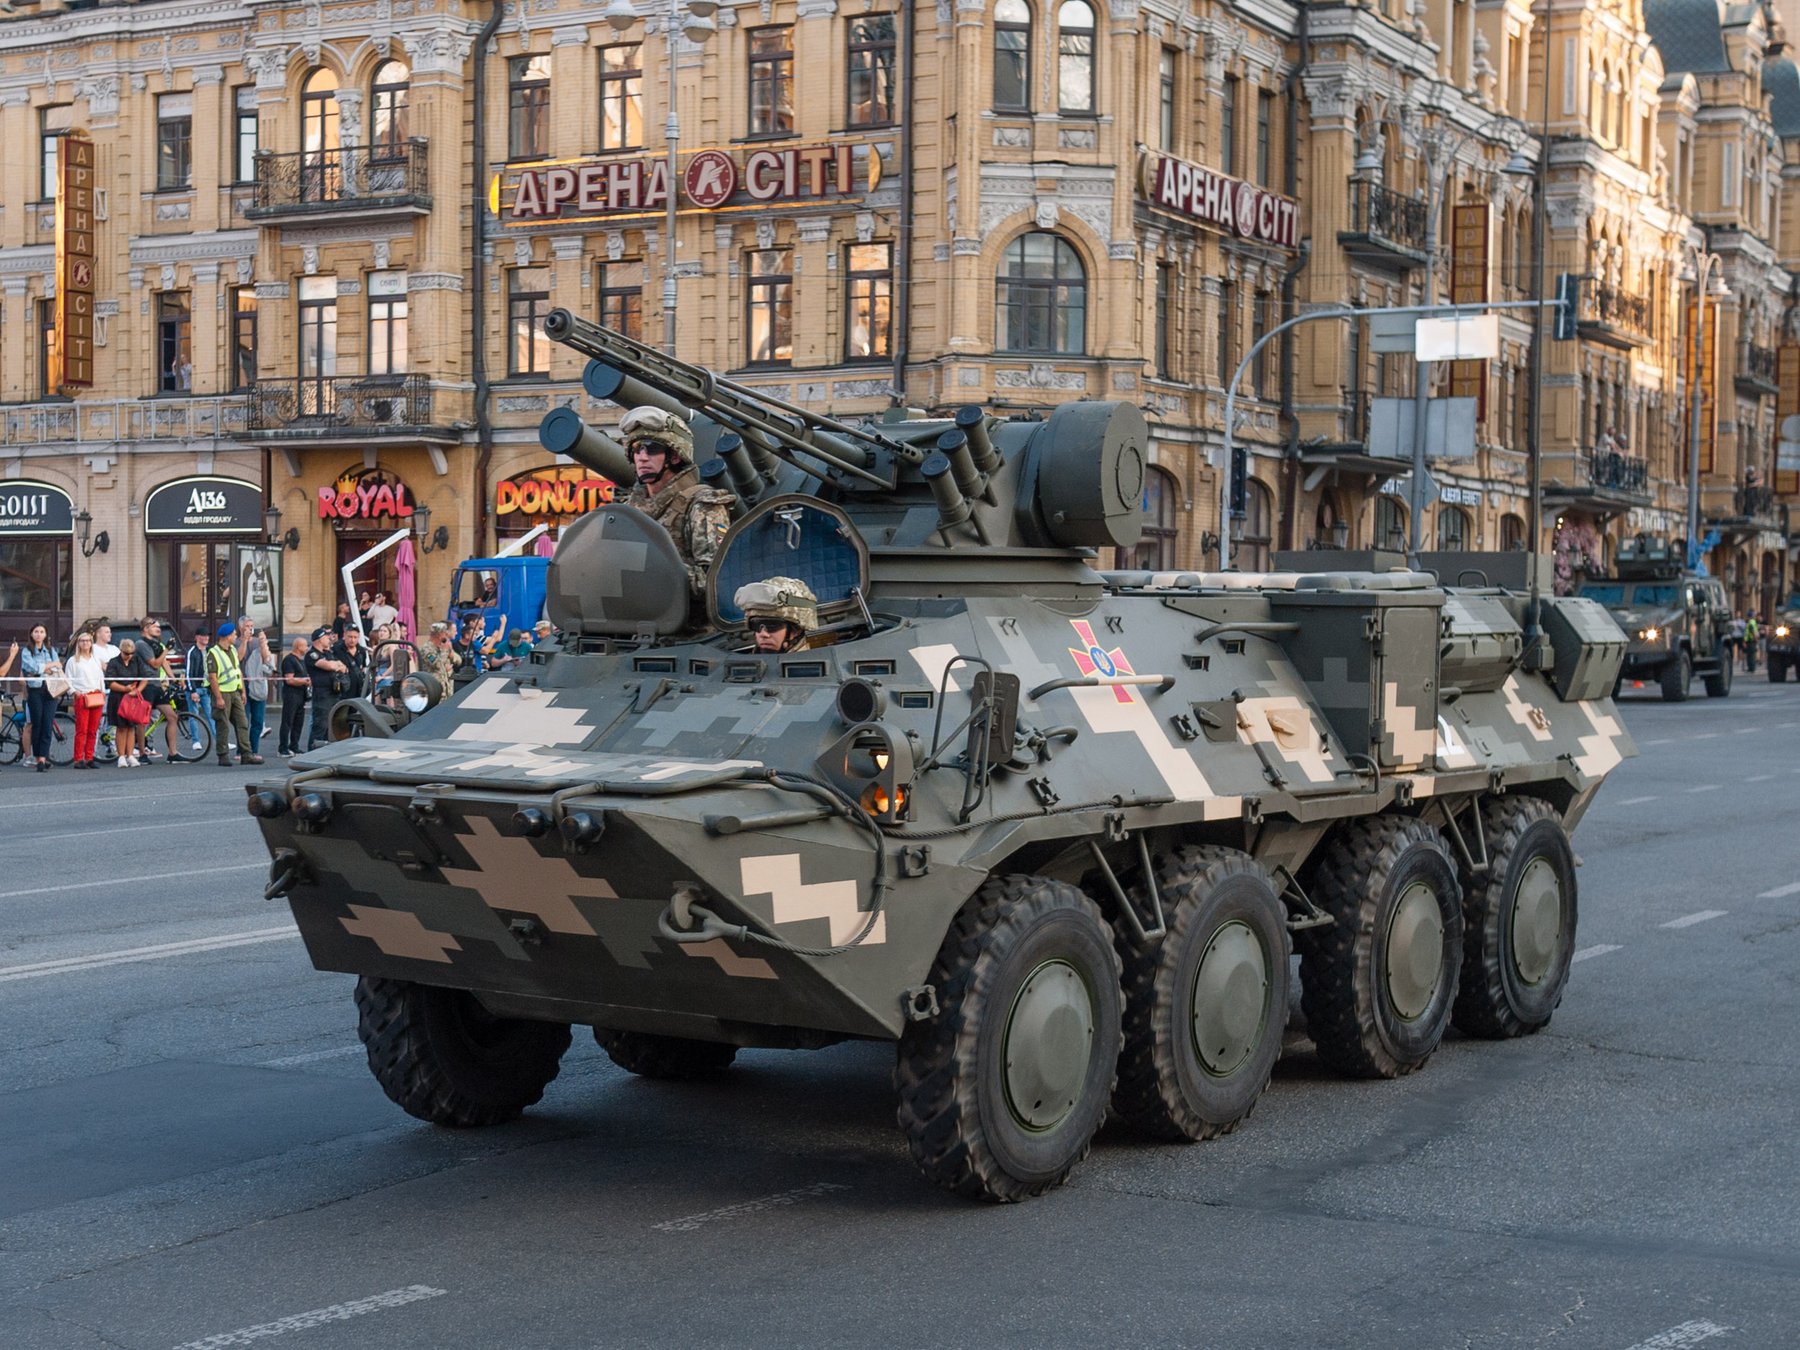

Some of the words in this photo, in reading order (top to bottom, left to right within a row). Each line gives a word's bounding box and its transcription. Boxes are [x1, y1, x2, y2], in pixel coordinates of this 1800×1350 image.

[510, 159, 669, 218] АРЕНА
[1161, 158, 1235, 227] АРЕНА
[318, 482, 414, 518] ROYAL
[496, 479, 616, 515] DONUTS
